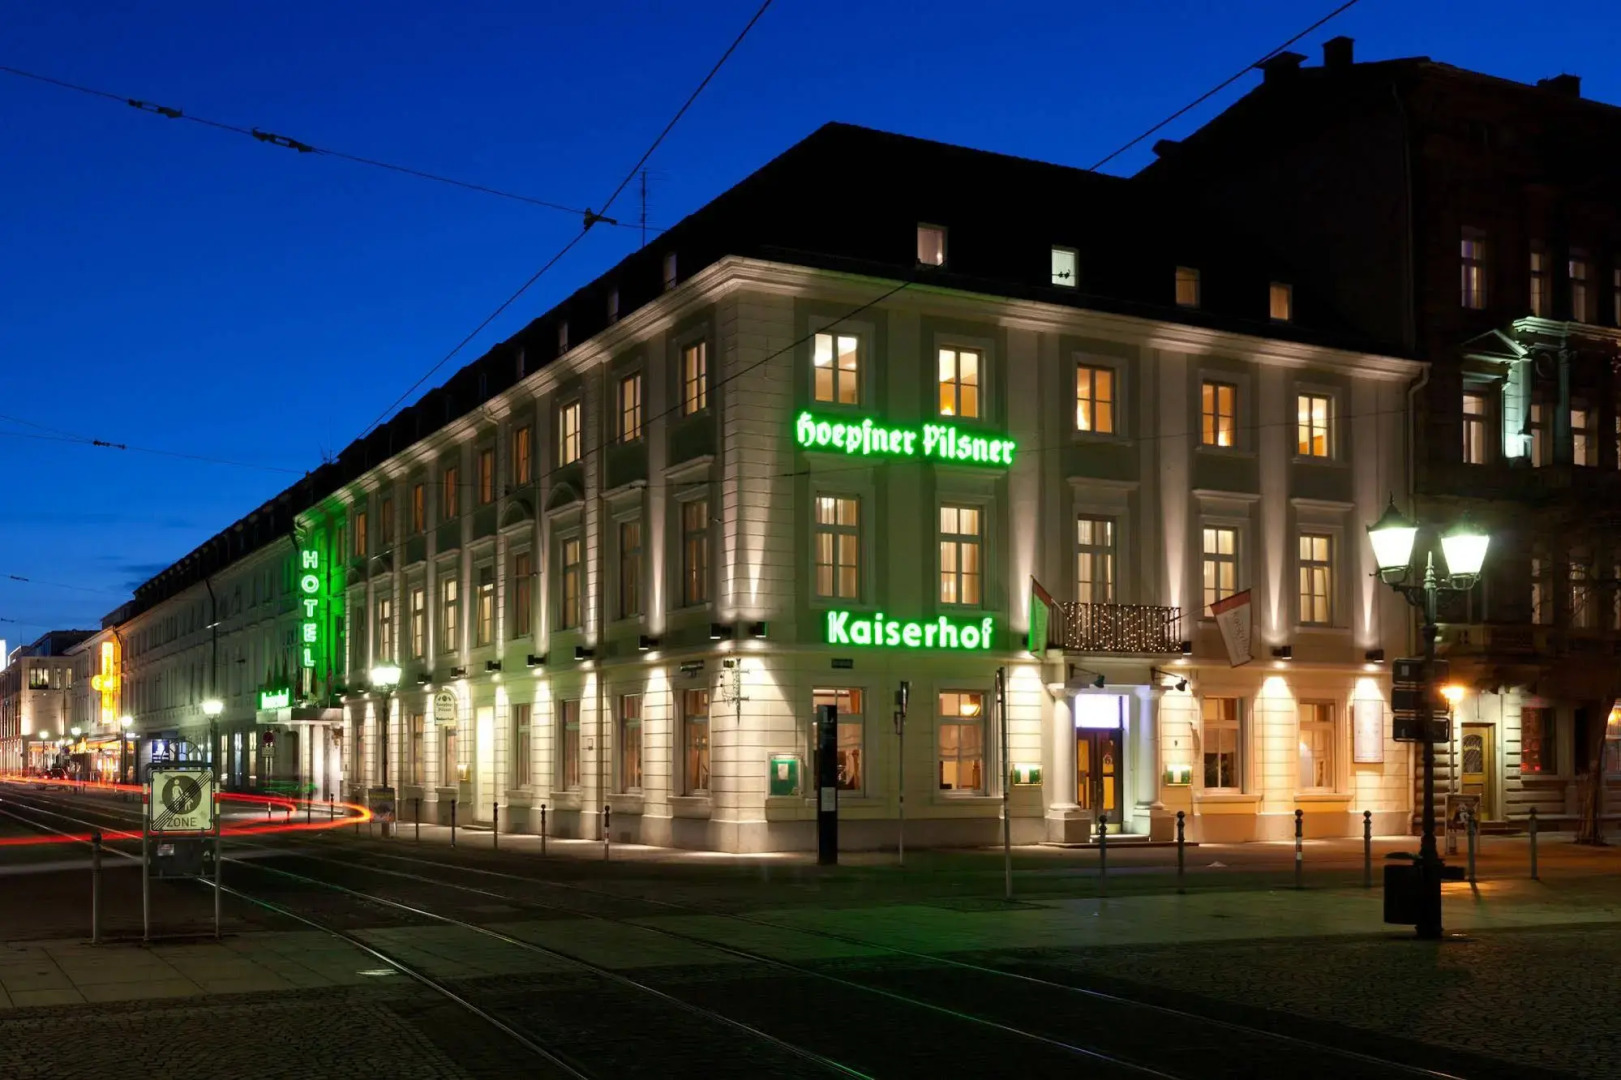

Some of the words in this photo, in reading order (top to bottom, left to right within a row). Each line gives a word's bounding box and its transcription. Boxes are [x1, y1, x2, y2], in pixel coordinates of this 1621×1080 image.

[796, 411, 917, 455] Hoepfner
[922, 423, 1016, 465] Pilsner
[301, 550, 319, 667] HOTEL
[828, 610, 993, 649] Kaiserhof
[166, 817, 198, 828] ZONE
